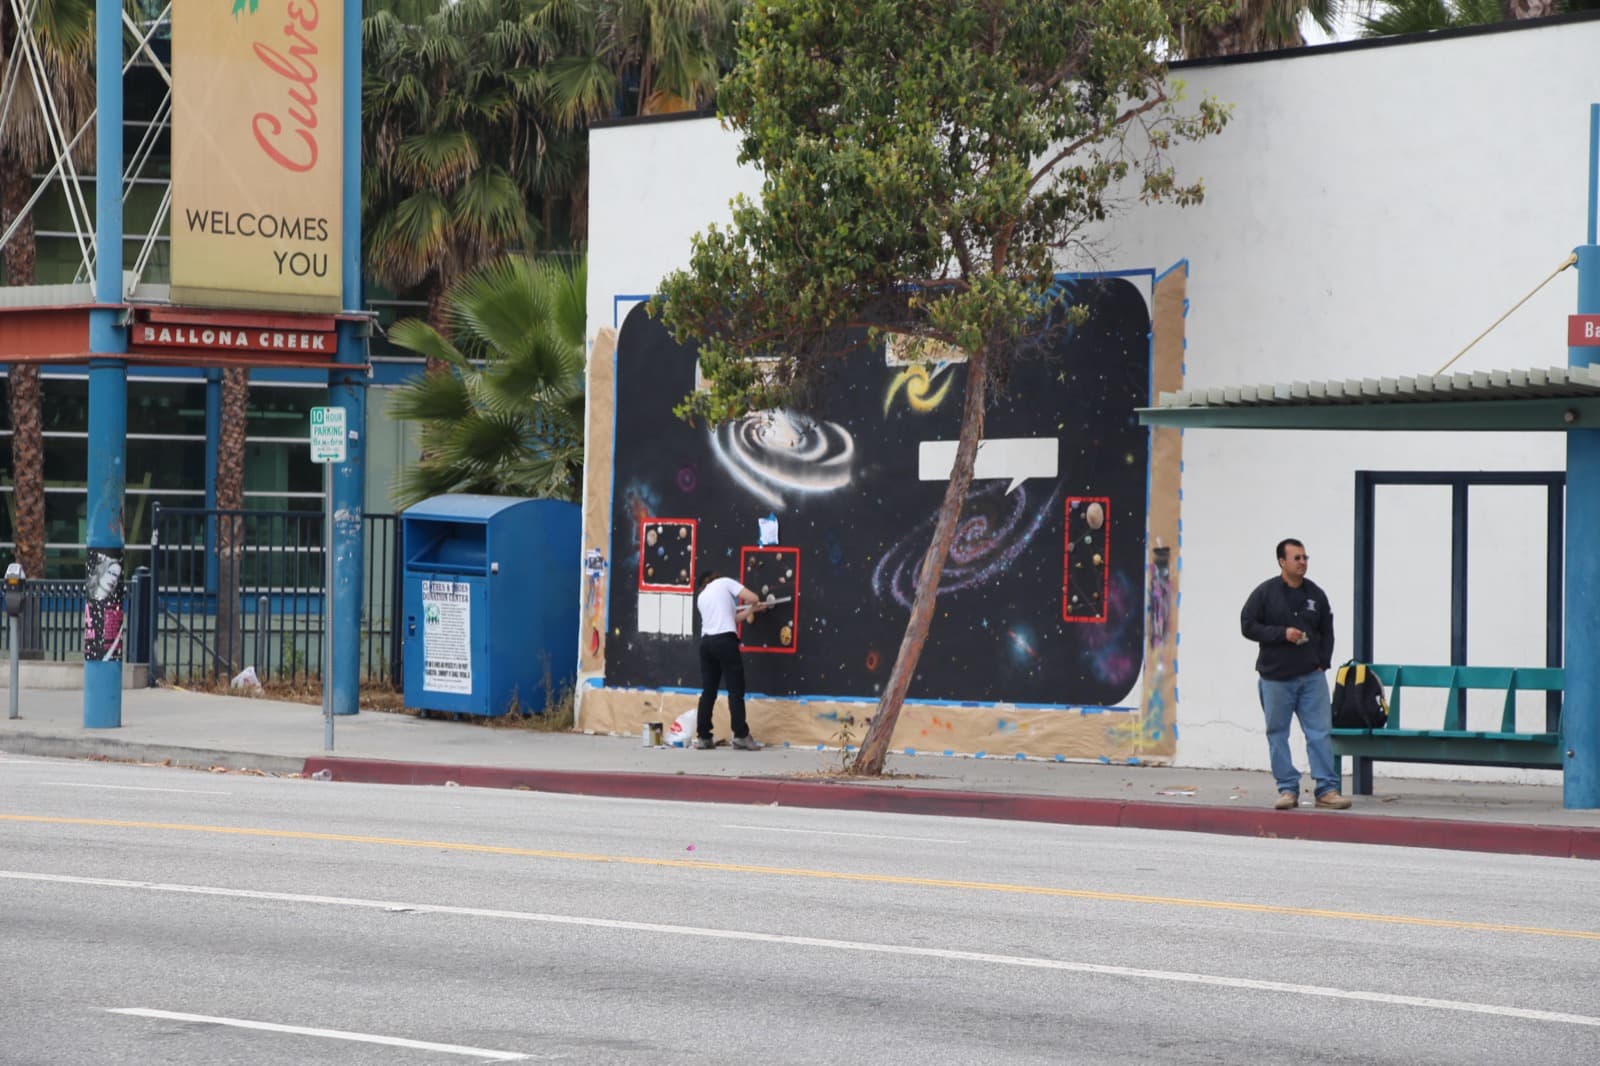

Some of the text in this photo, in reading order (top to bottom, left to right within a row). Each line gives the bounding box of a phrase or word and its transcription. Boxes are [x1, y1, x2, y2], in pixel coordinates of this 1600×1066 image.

[185, 208, 328, 242] WELCOMES
[273, 250, 328, 278] YOU
[144, 326, 325, 350] BALLONA CREEK
[313, 410, 342, 422] 10 HOUR
[314, 426, 343, 437] PARKING
